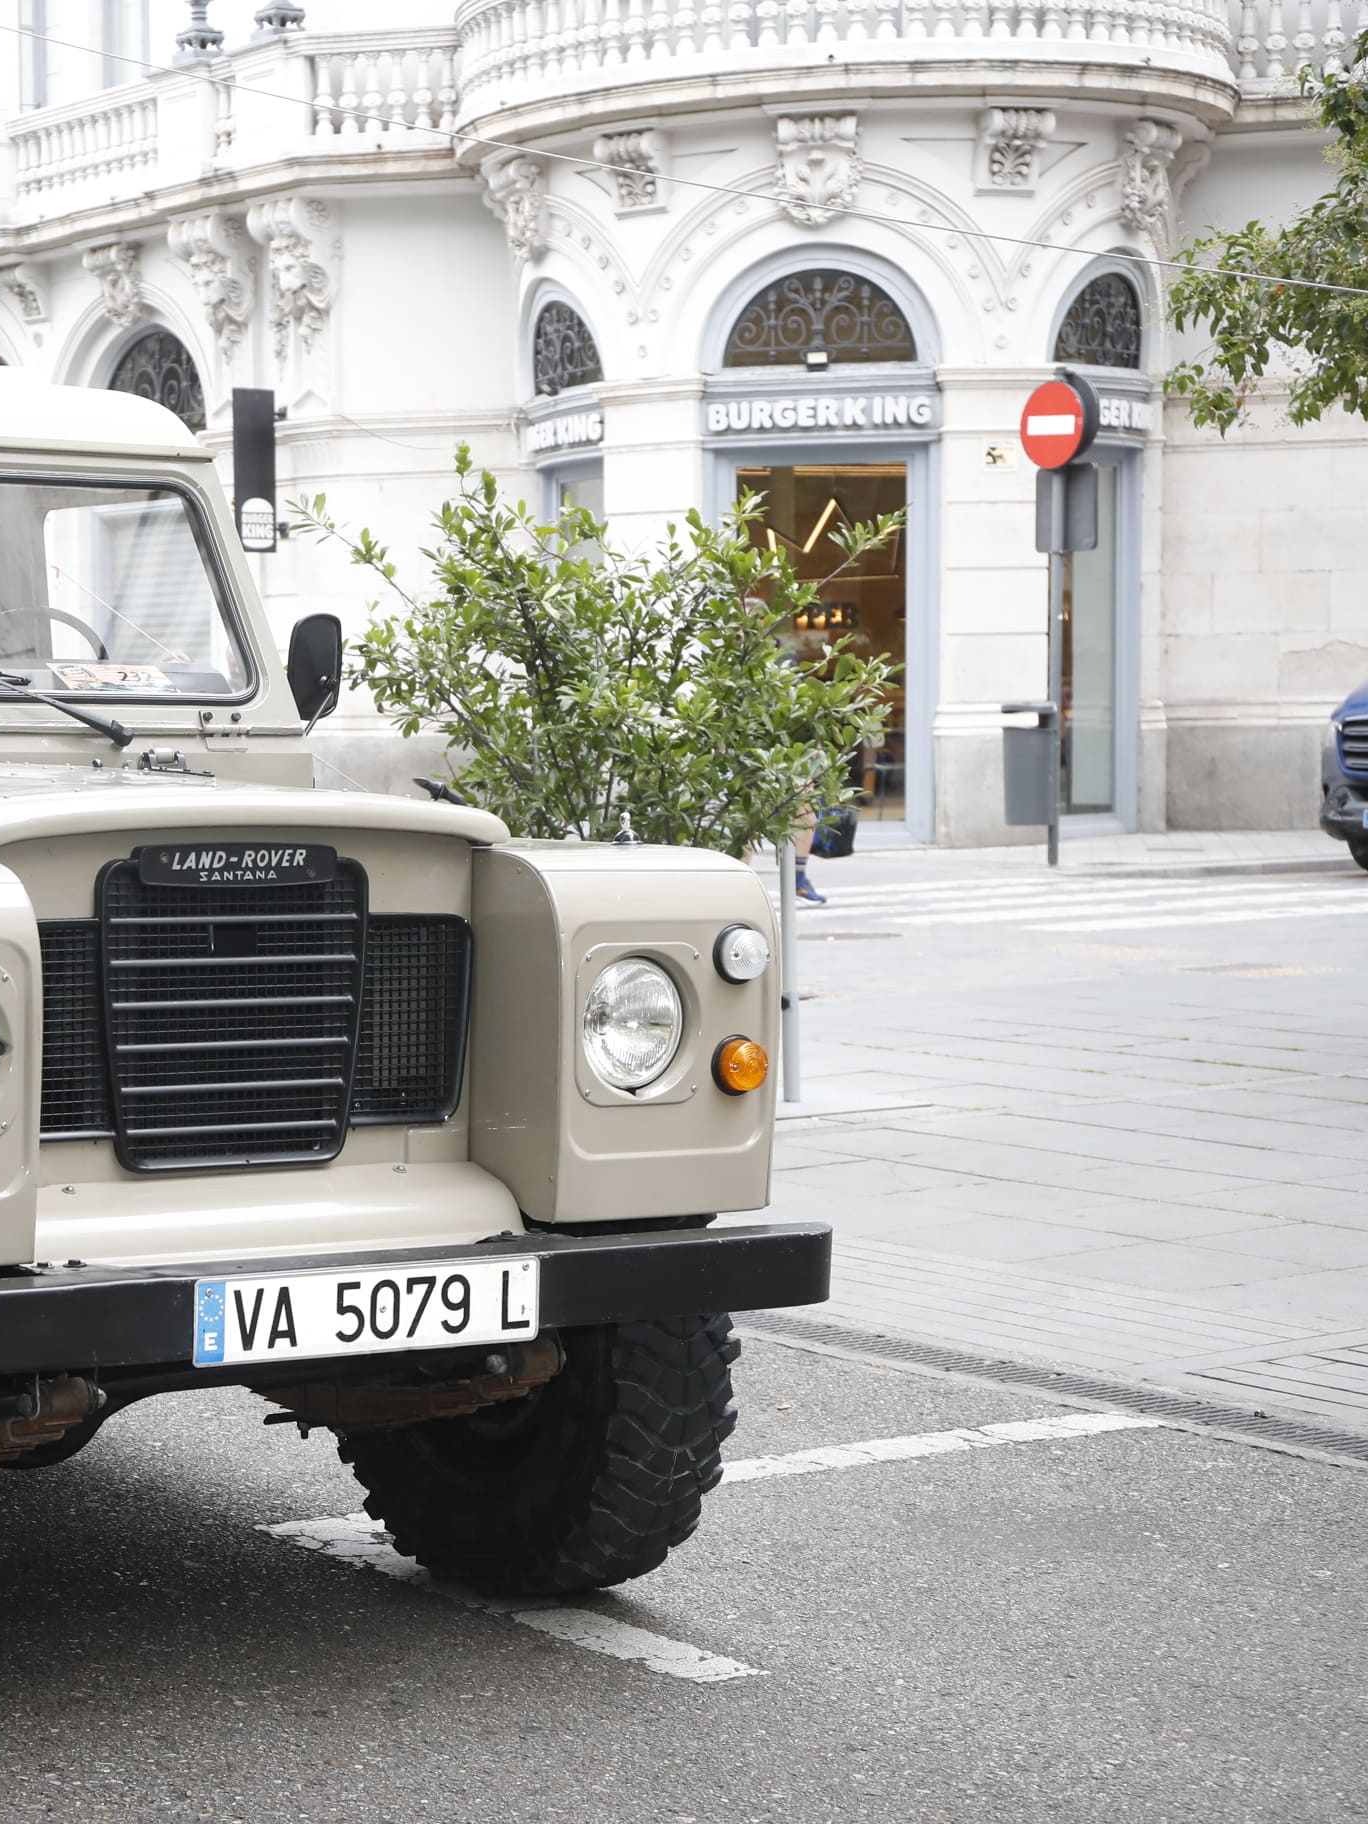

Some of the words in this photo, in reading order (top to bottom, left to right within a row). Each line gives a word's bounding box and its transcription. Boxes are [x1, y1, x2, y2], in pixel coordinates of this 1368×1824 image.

[1099, 398, 1130, 427] GER
[117, 671, 152, 682] 232
[171, 849, 307, 870] LAND-ROVER
[199, 870, 278, 882] SANTANA
[233, 1286, 298, 1352] VA
[334, 1273, 472, 1344] 5079
[501, 1270, 530, 1330] L
[203, 1332, 218, 1351] E
